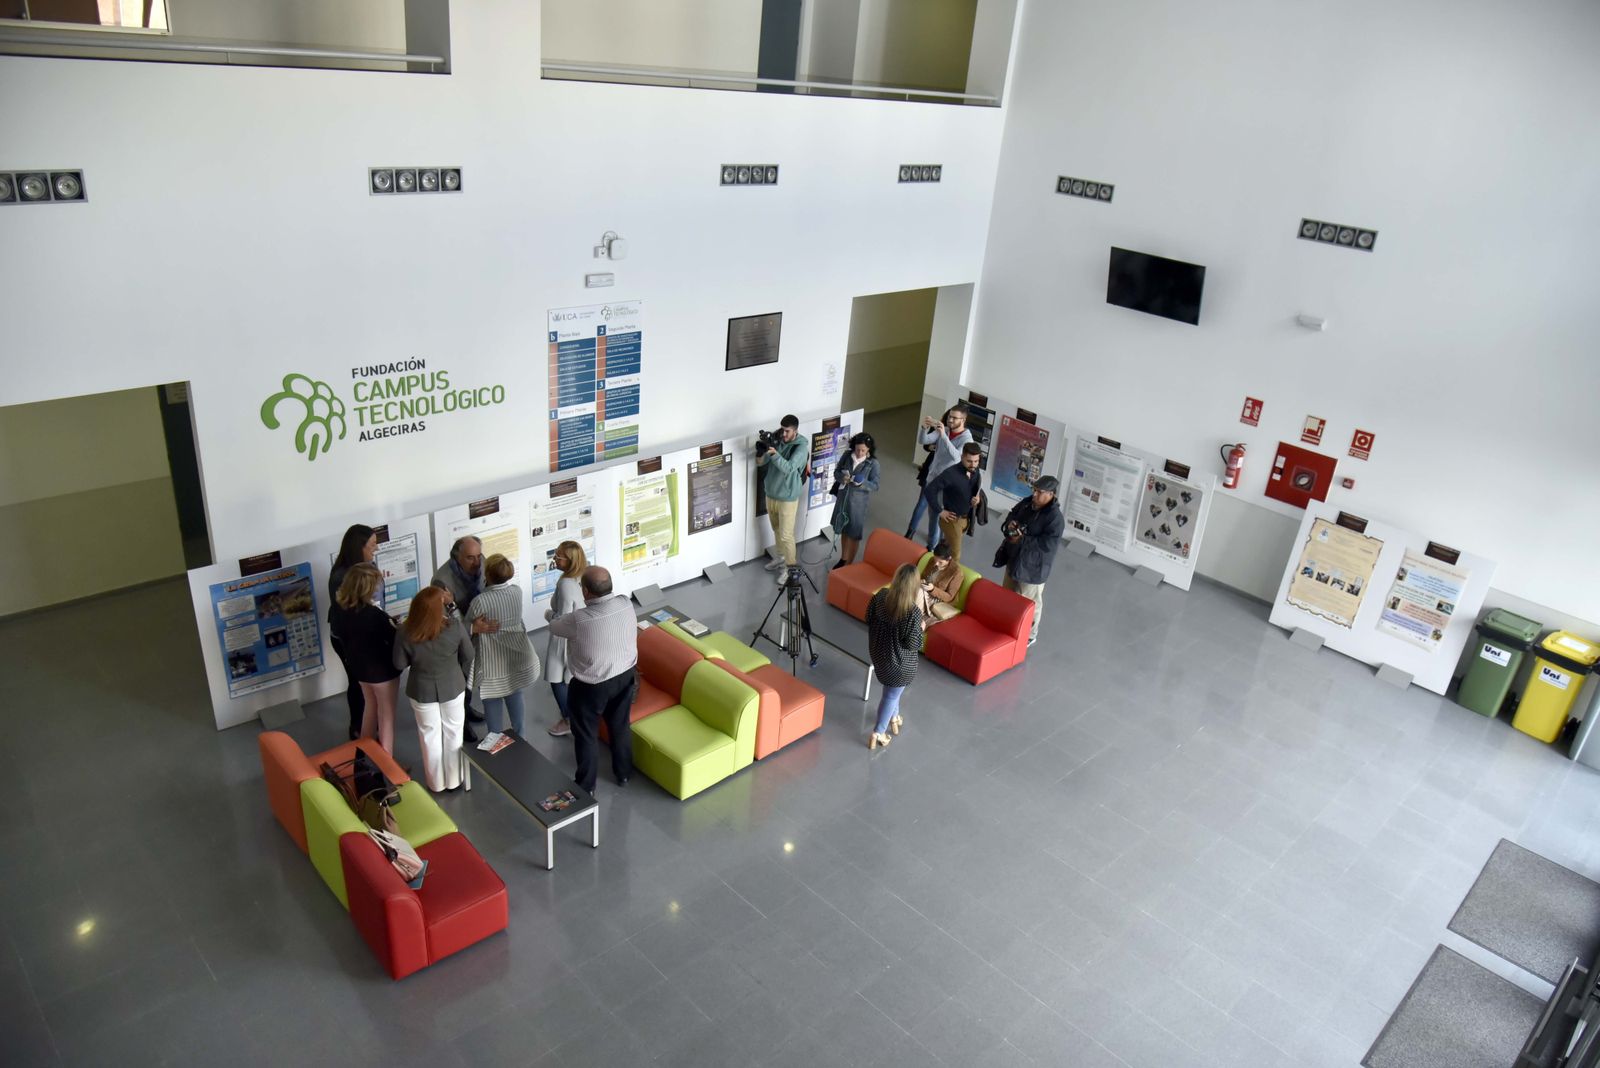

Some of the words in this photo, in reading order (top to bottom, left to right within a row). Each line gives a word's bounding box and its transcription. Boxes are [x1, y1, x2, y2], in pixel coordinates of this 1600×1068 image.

[599, 327, 604, 335] 2
[351, 356, 426, 379] FUNDACIÓN
[353, 370, 450, 403] CAMPUS
[353, 384, 505, 427] TECNOLÓGICO
[358, 421, 426, 442] ALGECIRAS
[1485, 645, 1502, 657] Uni
[1543, 667, 1561, 680] Uni
